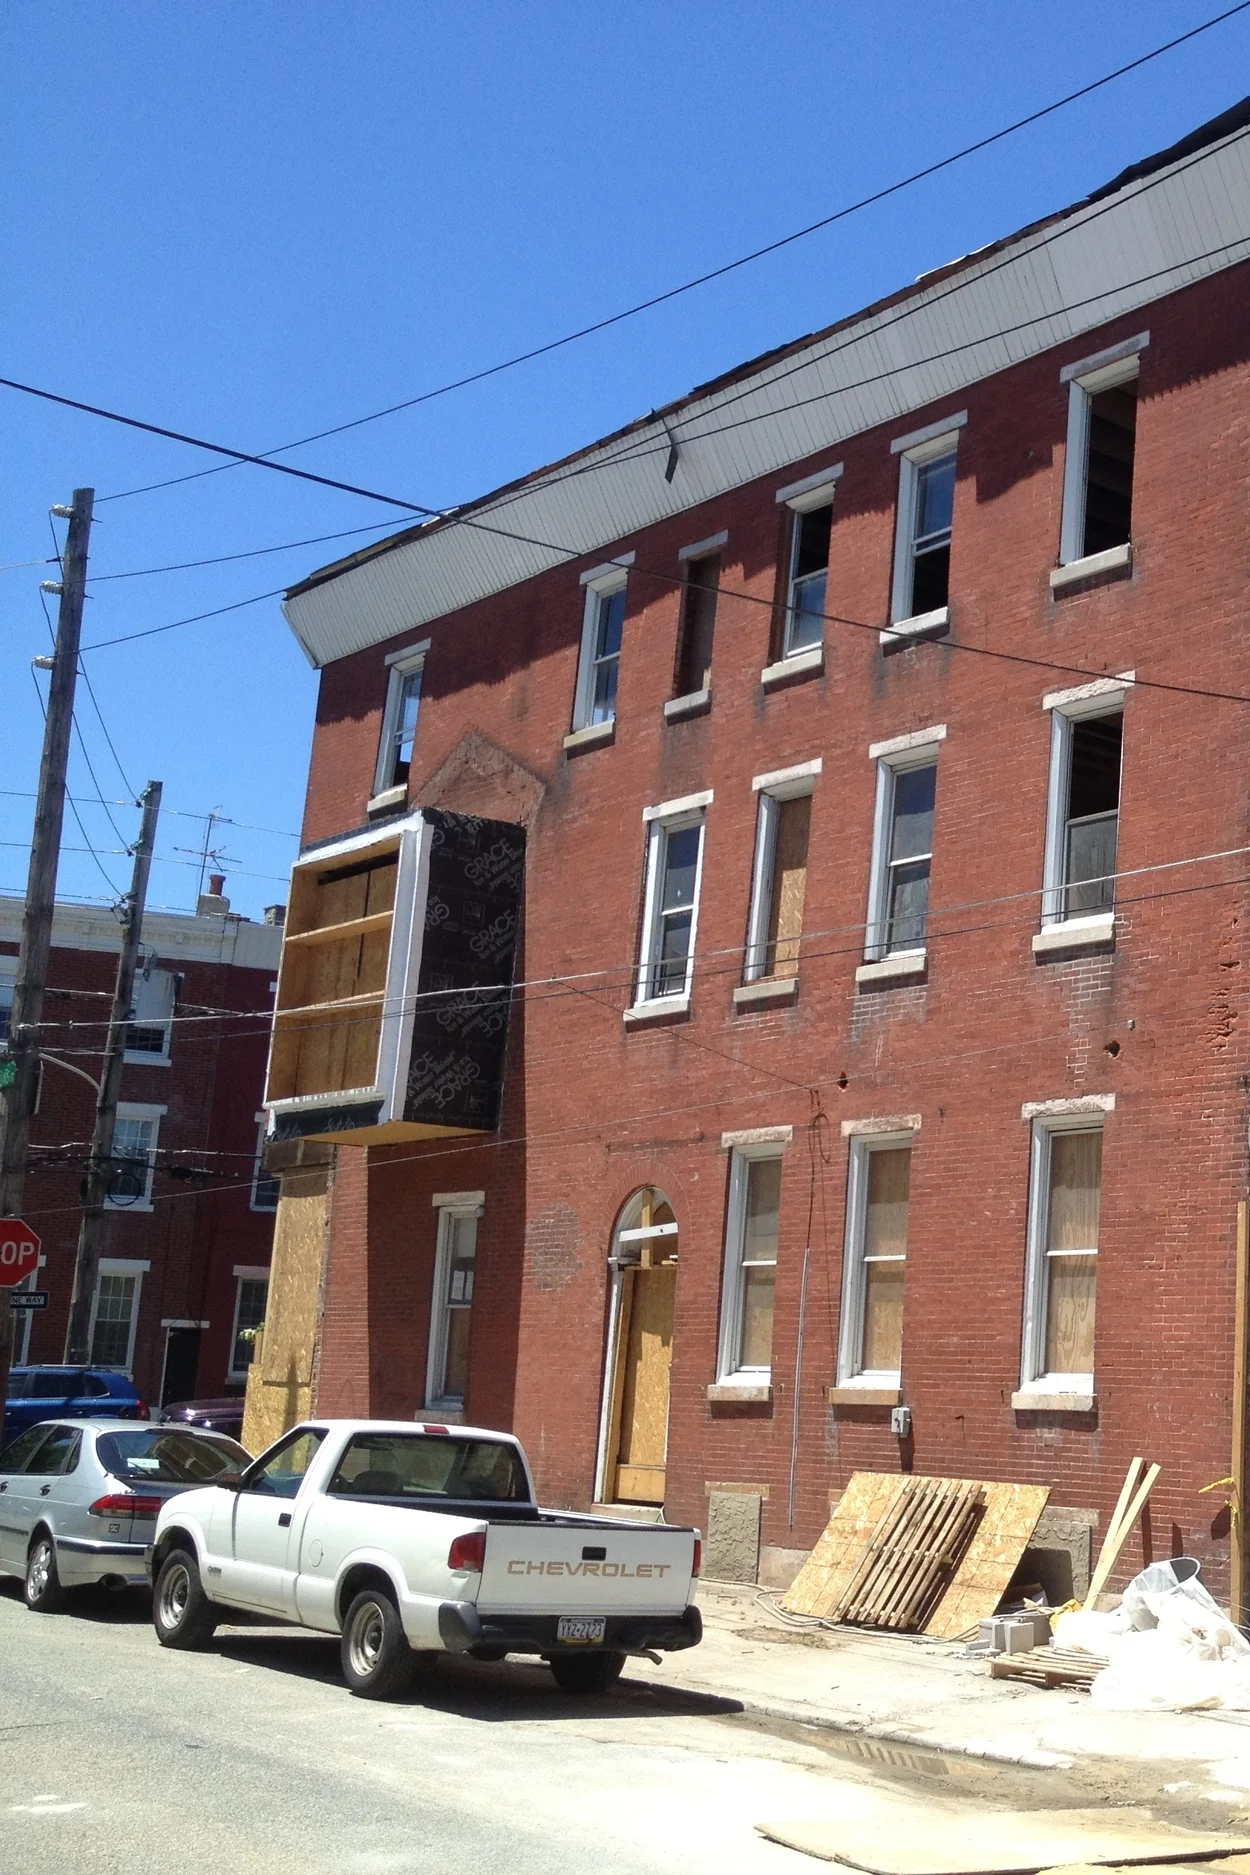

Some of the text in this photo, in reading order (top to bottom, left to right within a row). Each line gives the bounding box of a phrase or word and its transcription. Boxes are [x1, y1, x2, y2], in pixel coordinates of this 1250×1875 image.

[464, 838, 512, 879] GRACE
[425, 904, 450, 931] GRA
[469, 910, 515, 952] GRACE
[436, 981, 483, 1024] GRACE
[409, 1052, 435, 1085] ACE
[432, 1062, 480, 1108] GRACE
[0, 1241, 35, 1265] OP
[507, 1560, 671, 1578] CHEVROLET
